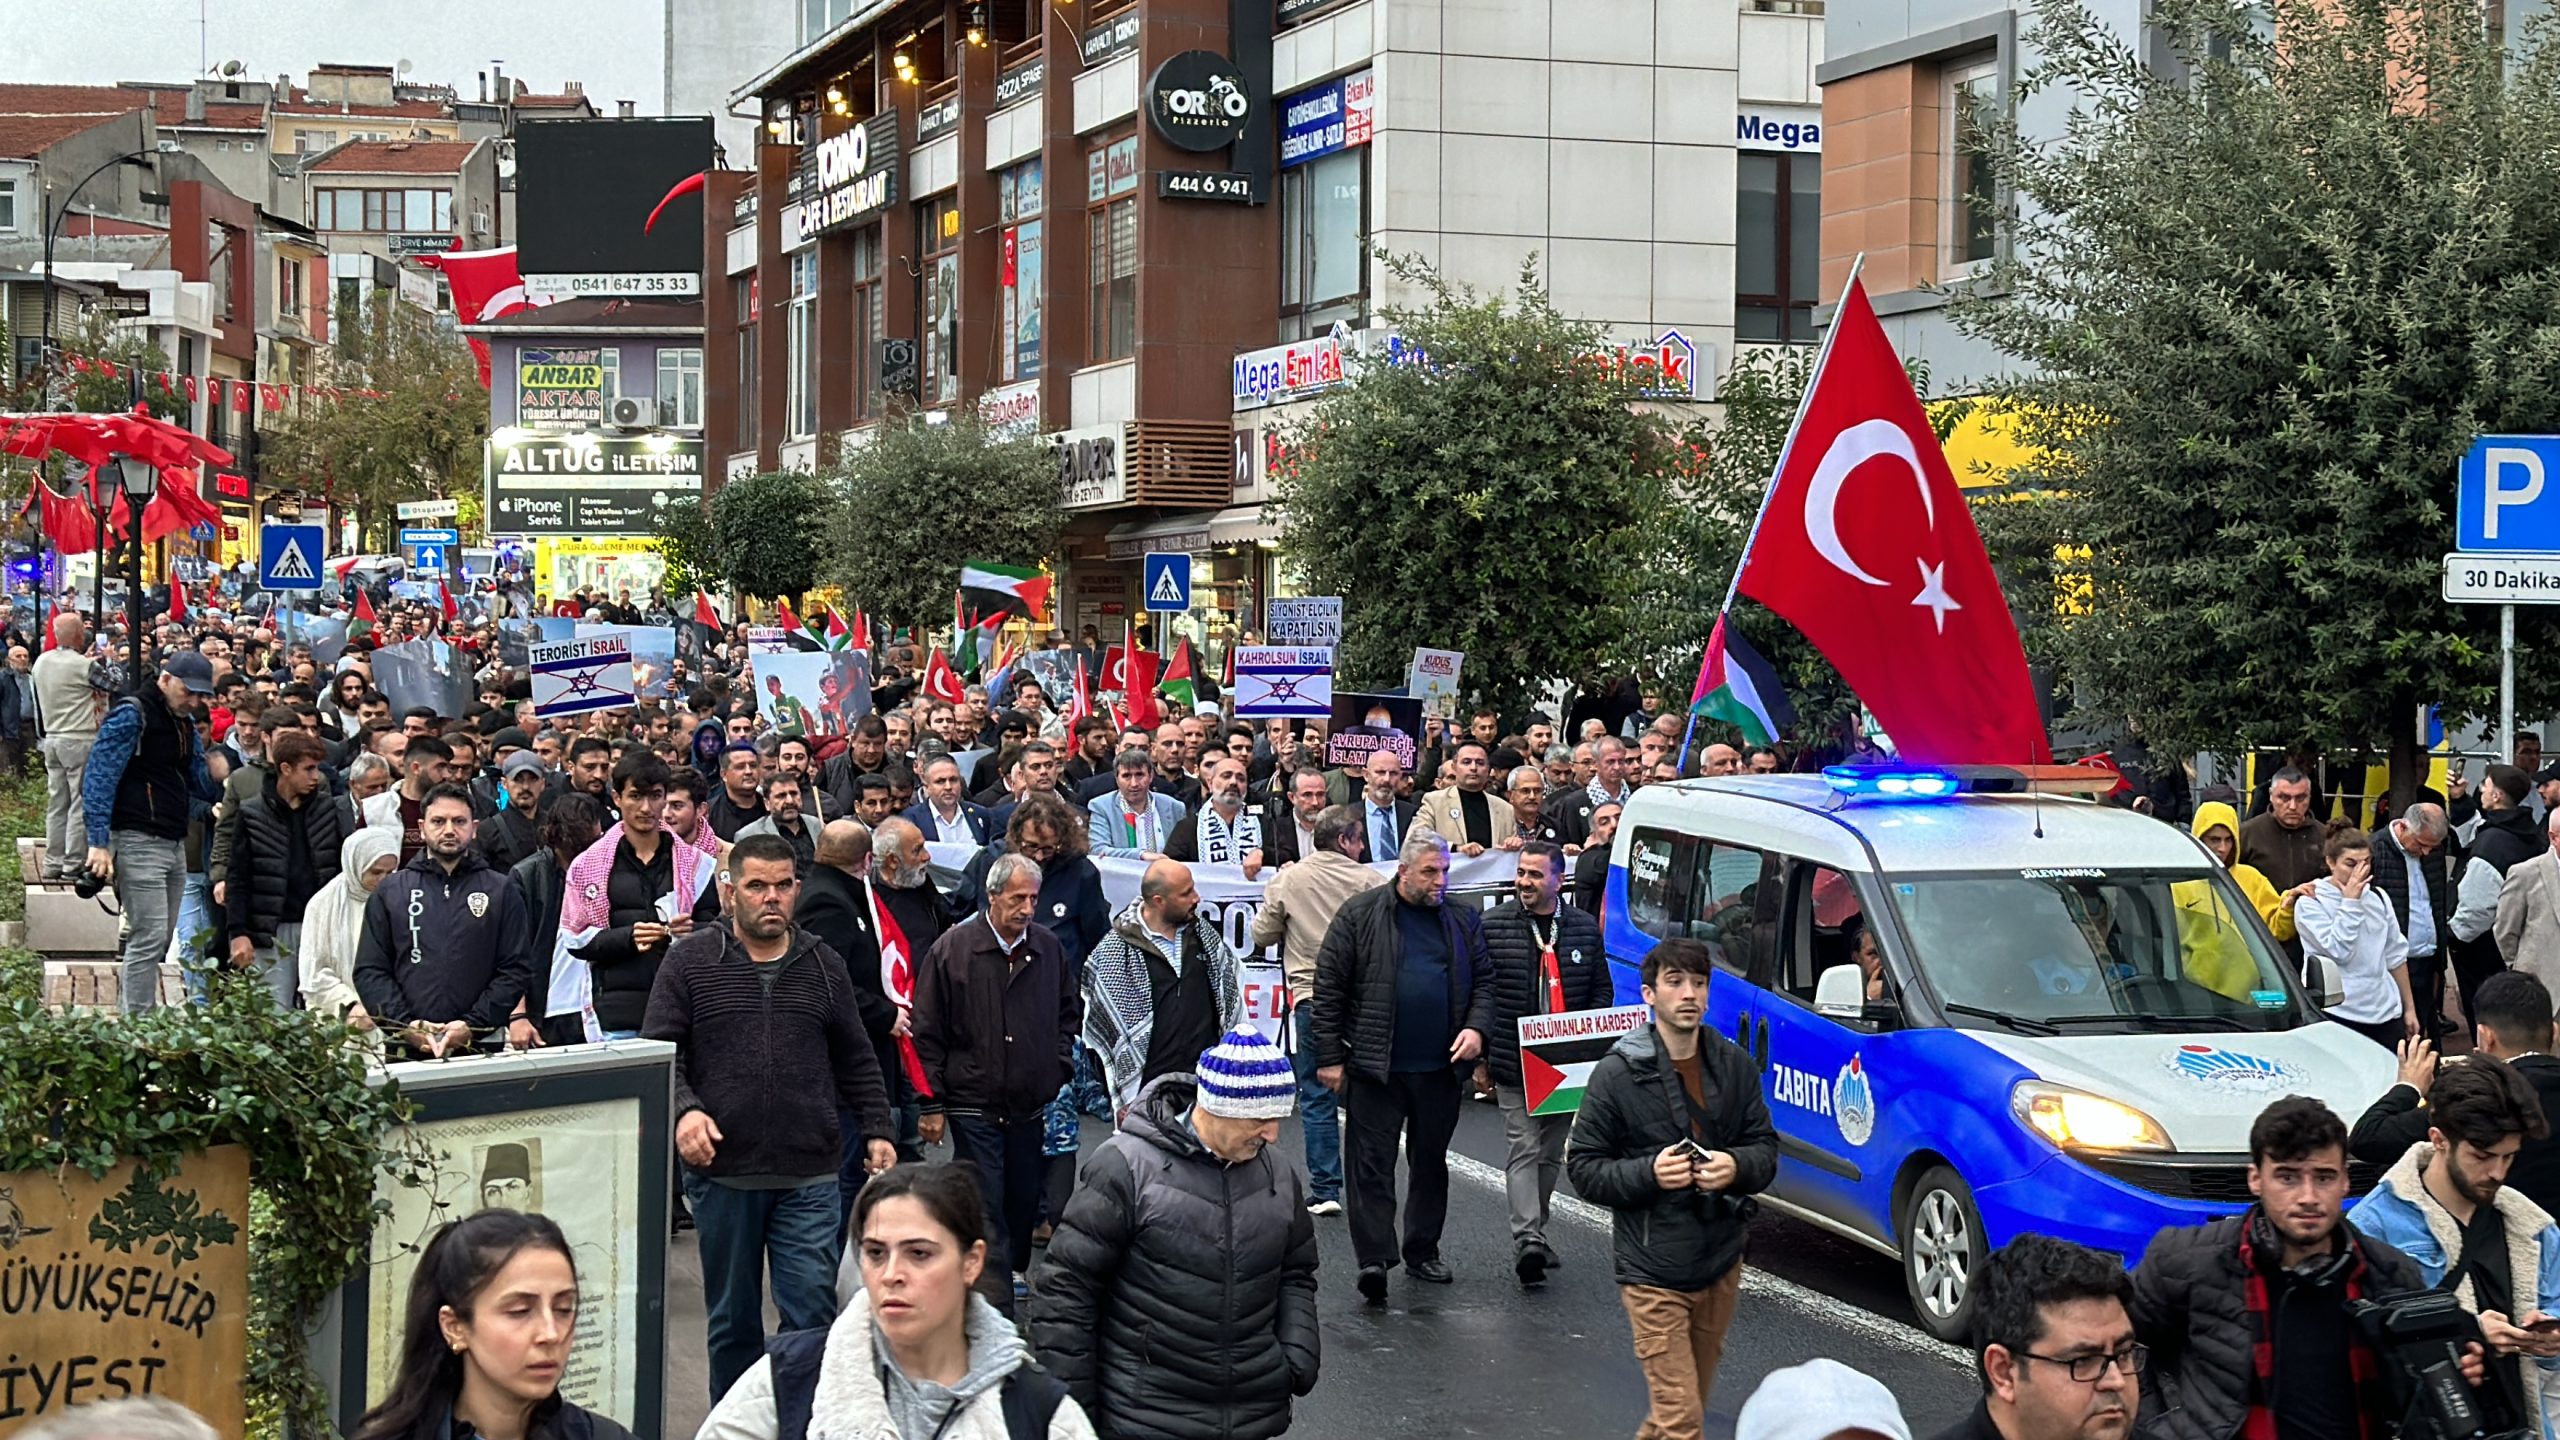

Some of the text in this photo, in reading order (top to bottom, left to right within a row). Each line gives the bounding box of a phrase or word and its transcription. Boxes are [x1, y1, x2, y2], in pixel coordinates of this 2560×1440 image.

[997, 75, 1020, 102] PİZZA
[1173, 117, 1229, 127] Pizzeria
[1737, 115, 1820, 148] Mega
[815, 122, 867, 192] TORNO
[1169, 176, 1248, 195] 444 6 941
[799, 170, 887, 236] CAFE & RESTAURANT
[572, 278, 608, 291] 0541
[613, 278, 641, 291] 647
[646, 278, 665, 290] 35
[669, 278, 689, 290] 33
[527, 366, 596, 385] ANBAR
[1234, 356, 1281, 402] Mega
[1285, 339, 1344, 387] Emlak
[521, 389, 602, 407] AKTAR
[521, 407, 600, 420] YÖRESEL ÜRÜNLER
[2484, 448, 2545, 539] P
[513, 497, 563, 513] iPhone
[527, 514, 563, 526] Servis
[2465, 570, 2560, 589] 30 Dakika
[1271, 621, 1336, 638] KAPATILSIN
[532, 633, 627, 662] TERORİST İSRAİL
[1238, 649, 1329, 665] KAHROLSUN İSRAİL
[1331, 733, 1416, 751] AVRUPA DEĞİL
[1329, 746, 1367, 764] İSLAM
[1522, 1018, 1594, 1041] MÜSLÜMANLAR
[1773, 1063, 1832, 1117] ZABITA
